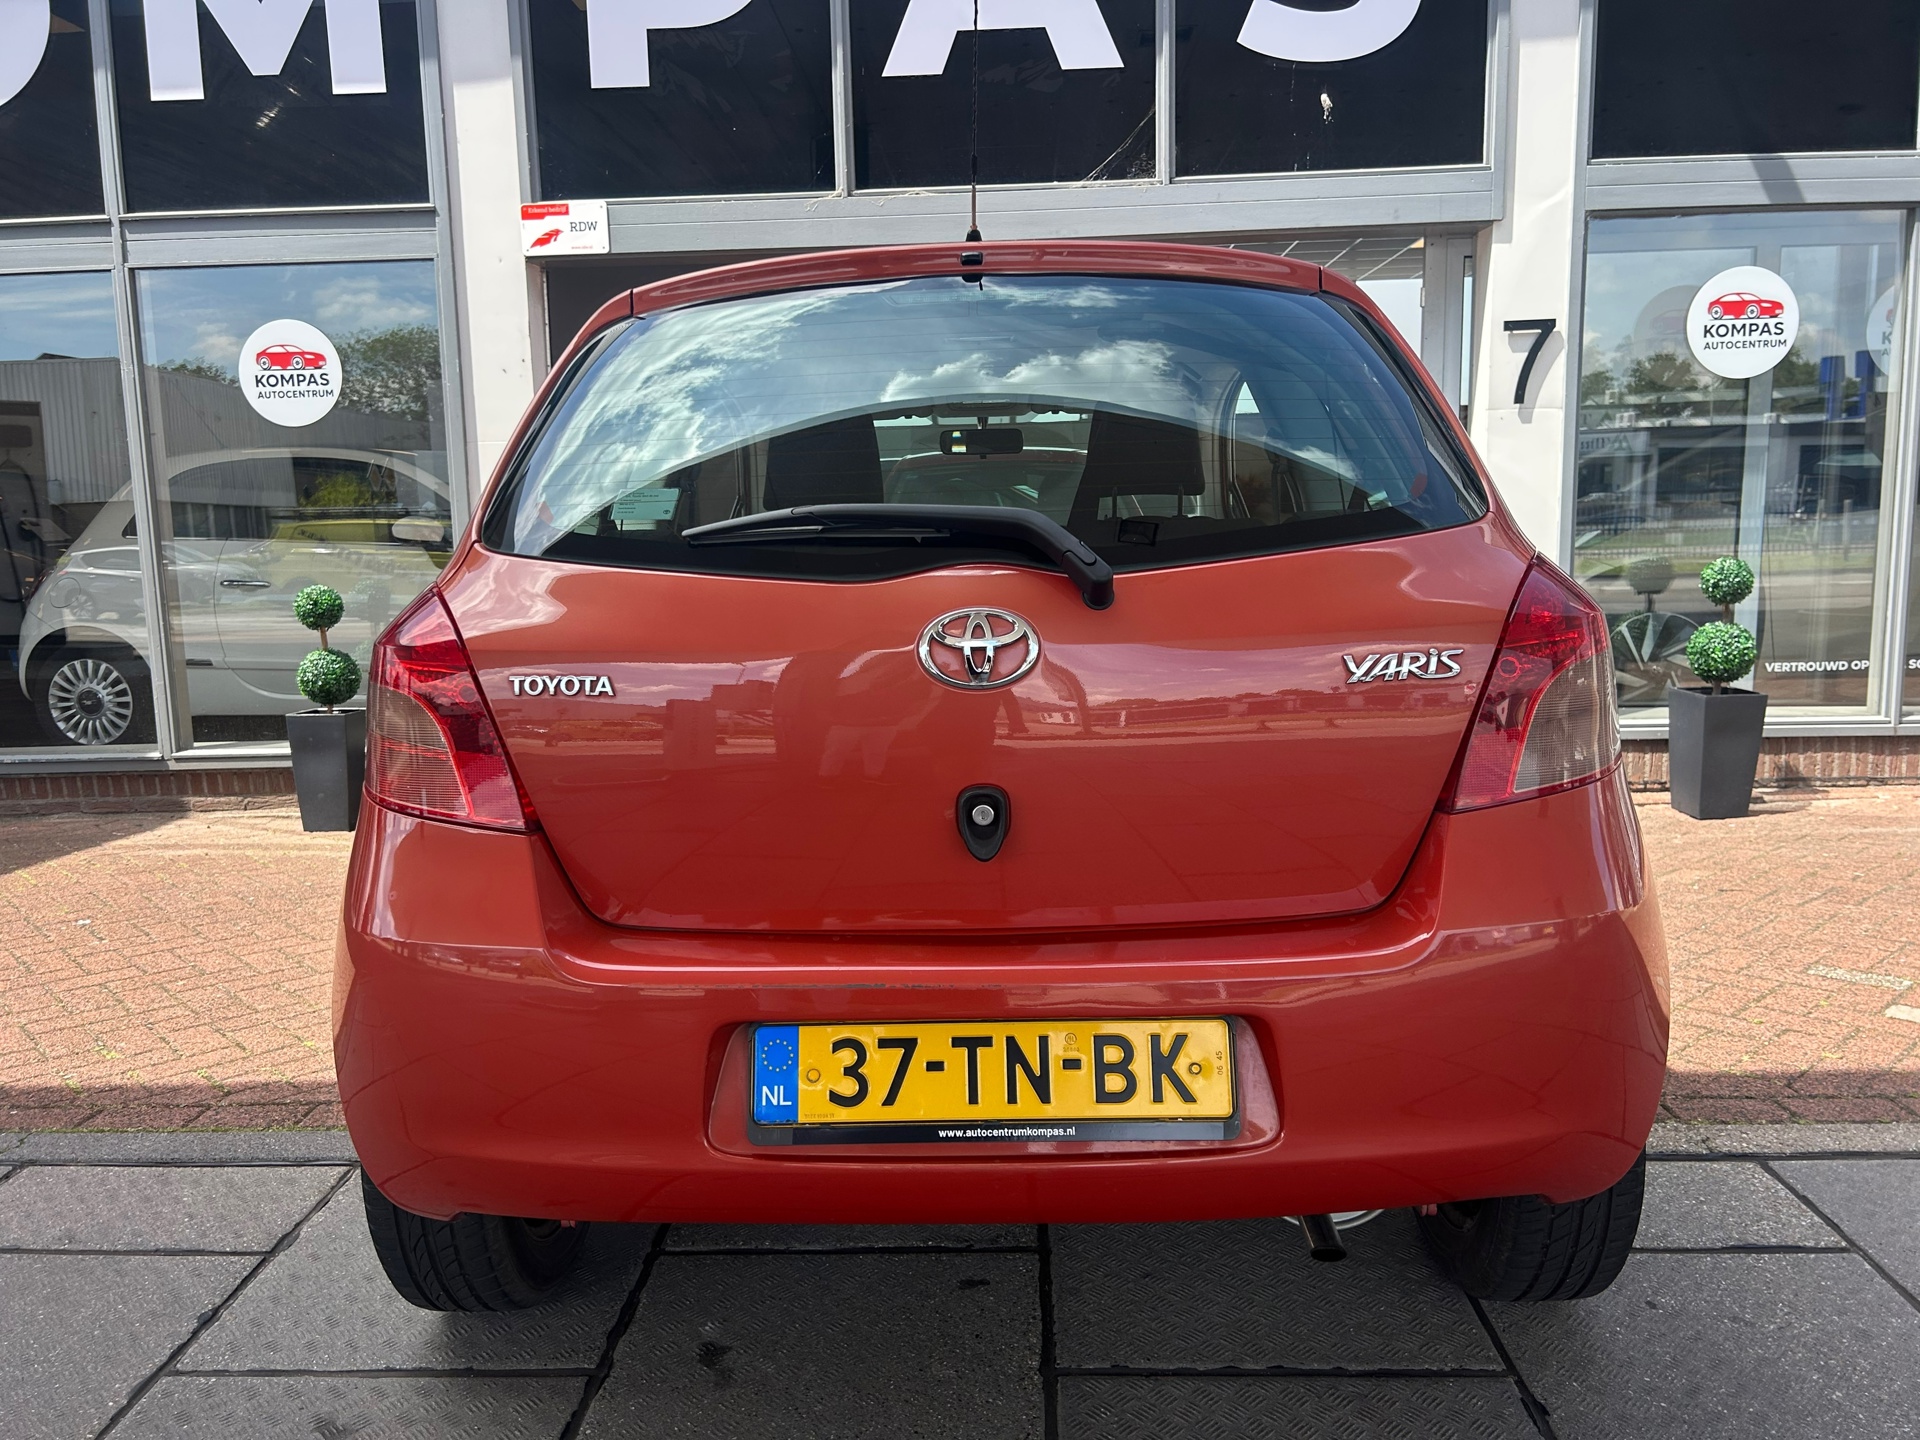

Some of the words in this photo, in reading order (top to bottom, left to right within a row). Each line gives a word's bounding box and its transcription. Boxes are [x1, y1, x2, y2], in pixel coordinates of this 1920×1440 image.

[570, 221, 598, 232] RDW
[1703, 321, 1784, 338] KOMPAS
[1703, 339, 1787, 350] AUTOCENTRUM
[1503, 318, 1556, 404] 7
[255, 373, 330, 388] KOMPAS
[257, 389, 334, 399] AUTOCENTRUM
[1764, 661, 1848, 673] VERTROUWD
[1850, 660, 1870, 671] OP
[508, 674, 616, 696] TOYOTA
[827, 1034, 1198, 1108] 37-TN-BK
[762, 1085, 792, 1107] NL
[938, 1126, 1076, 1138] www.autocentrumkompas.nl
